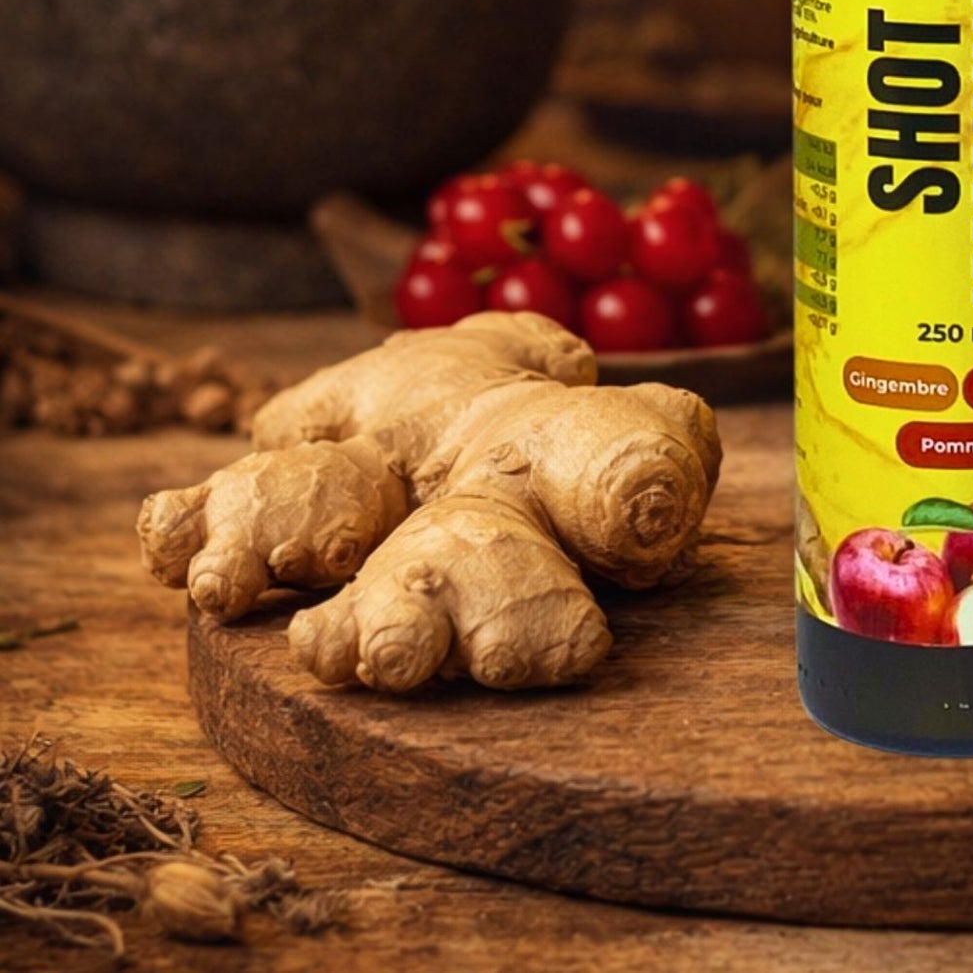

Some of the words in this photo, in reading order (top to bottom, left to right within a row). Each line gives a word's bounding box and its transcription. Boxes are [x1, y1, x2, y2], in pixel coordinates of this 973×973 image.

[867, 8, 961, 214] SHOT
[918, 323, 964, 343] 250
[849, 371, 949, 398] Gingembre
